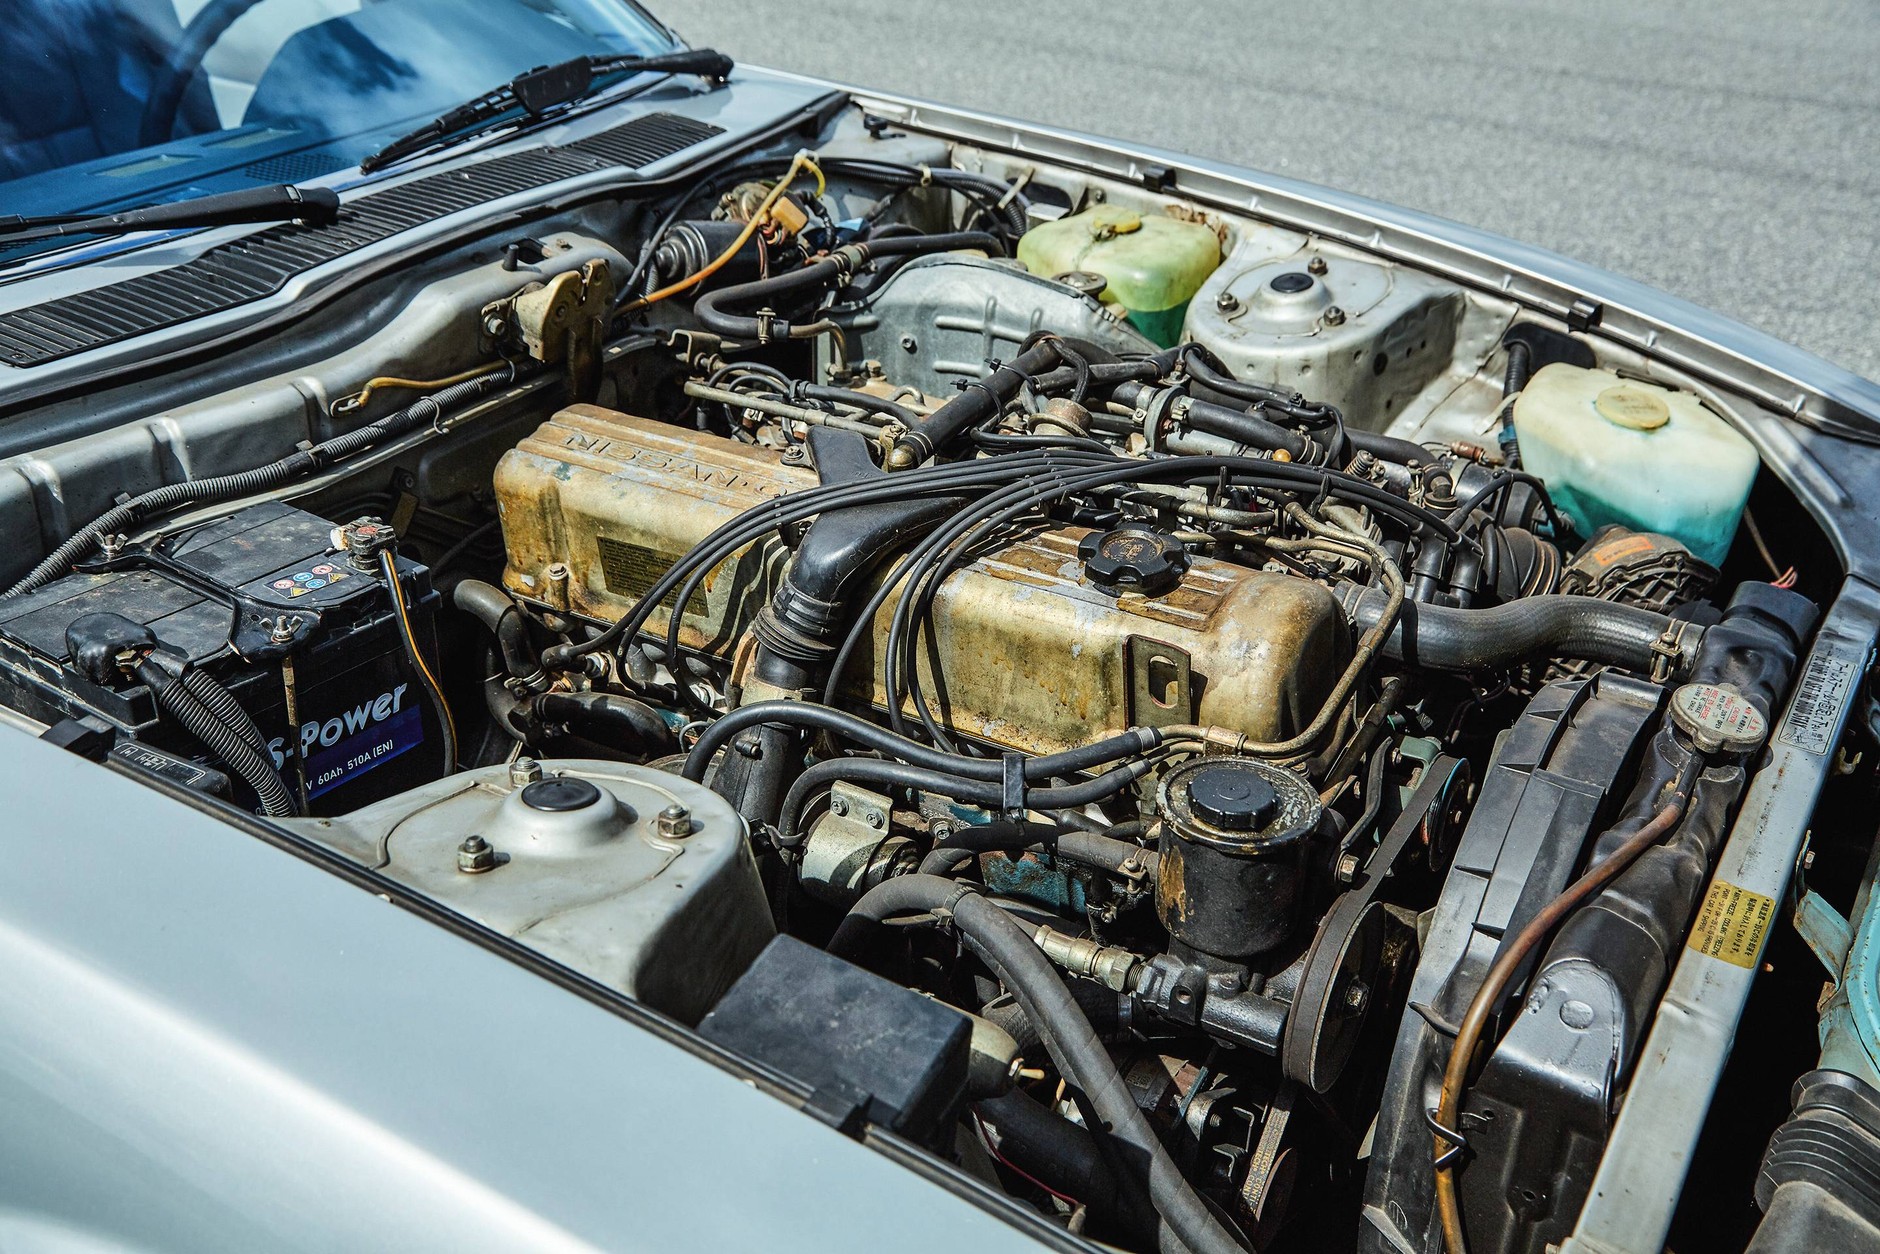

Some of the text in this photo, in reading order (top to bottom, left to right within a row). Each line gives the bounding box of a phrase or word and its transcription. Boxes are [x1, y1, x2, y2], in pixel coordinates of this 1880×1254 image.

[565, 433, 739, 488] NISSAN
[1729, 707, 1740, 724] CAUTION
[1788, 711, 1810, 729] STAY
[318, 766, 343, 785] 60Ah
[347, 753, 371, 770] 510A
[373, 739, 393, 758] (EN)
